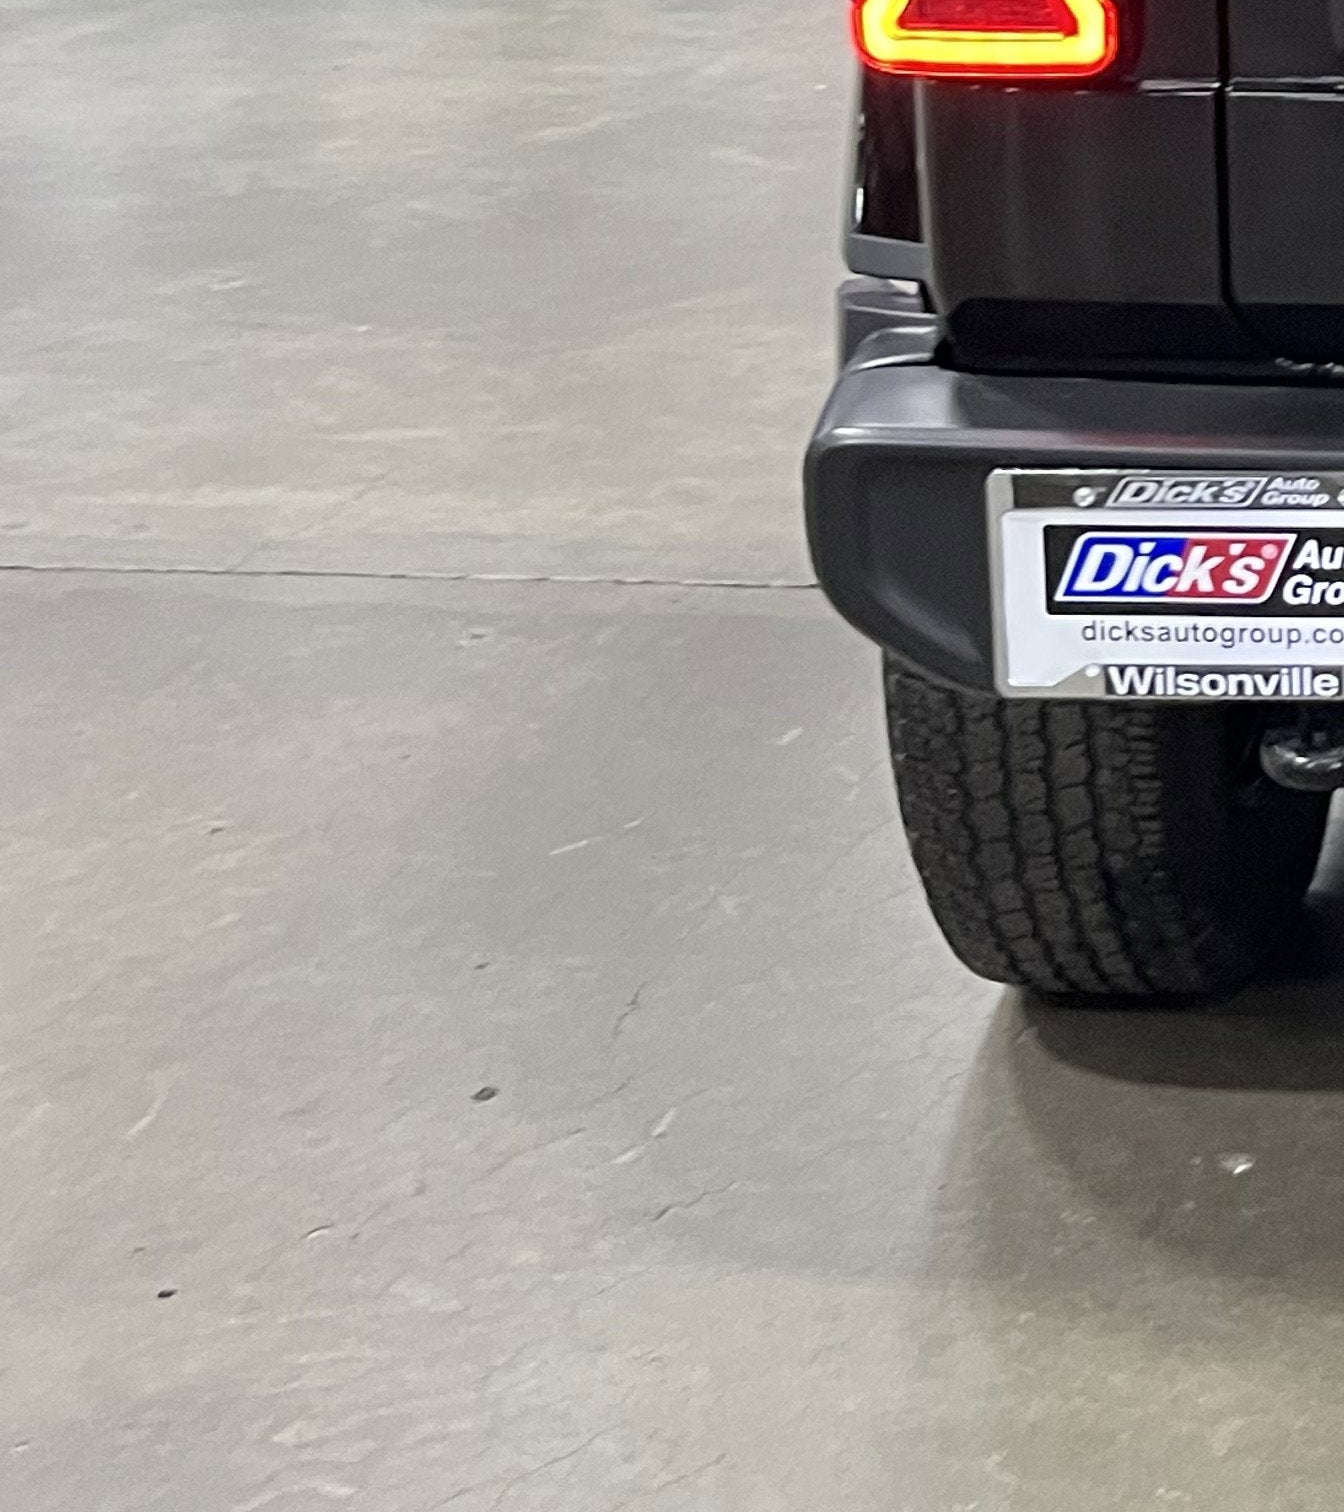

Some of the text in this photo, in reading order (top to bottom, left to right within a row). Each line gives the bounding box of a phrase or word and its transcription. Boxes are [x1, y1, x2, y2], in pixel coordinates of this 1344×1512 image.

[1117, 480, 1253, 504] Dick's
[1266, 477, 1320, 492] Auto
[1260, 491, 1330, 507] Group
[1072, 541, 1265, 595] Dick's
[1107, 666, 1340, 697] Wilsonville
